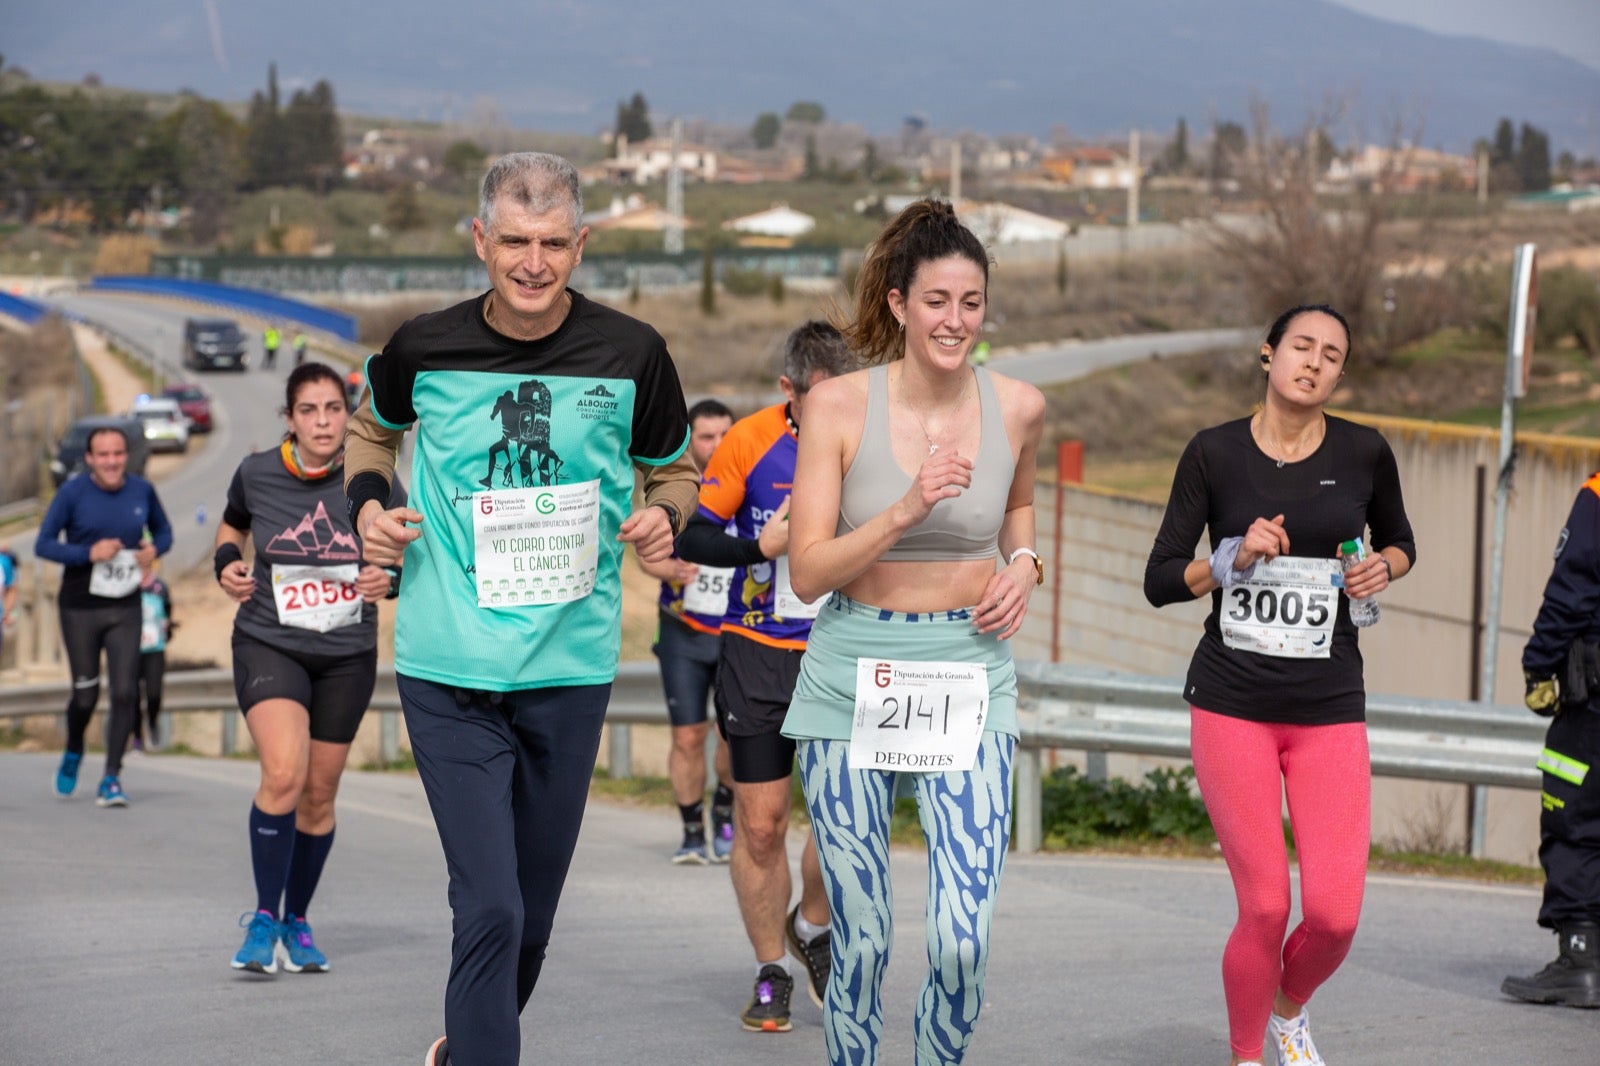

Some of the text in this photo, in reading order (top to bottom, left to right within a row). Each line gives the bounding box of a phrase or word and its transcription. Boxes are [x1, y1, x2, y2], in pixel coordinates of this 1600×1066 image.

[577, 400, 618, 409] ALBOLOTE
[494, 498, 525, 506] Diputación
[517, 522, 523, 530] DE
[525, 521, 541, 529] FONDO
[492, 533, 585, 554] YO CORRO CONTRA
[513, 554, 570, 572] EL CÁNCER
[282, 579, 357, 611] 2058
[1228, 587, 1329, 627] 3005
[894, 670, 975, 680] Diputación de Granada
[877, 694, 950, 735] 2141
[875, 751, 954, 767] DEPORTES
